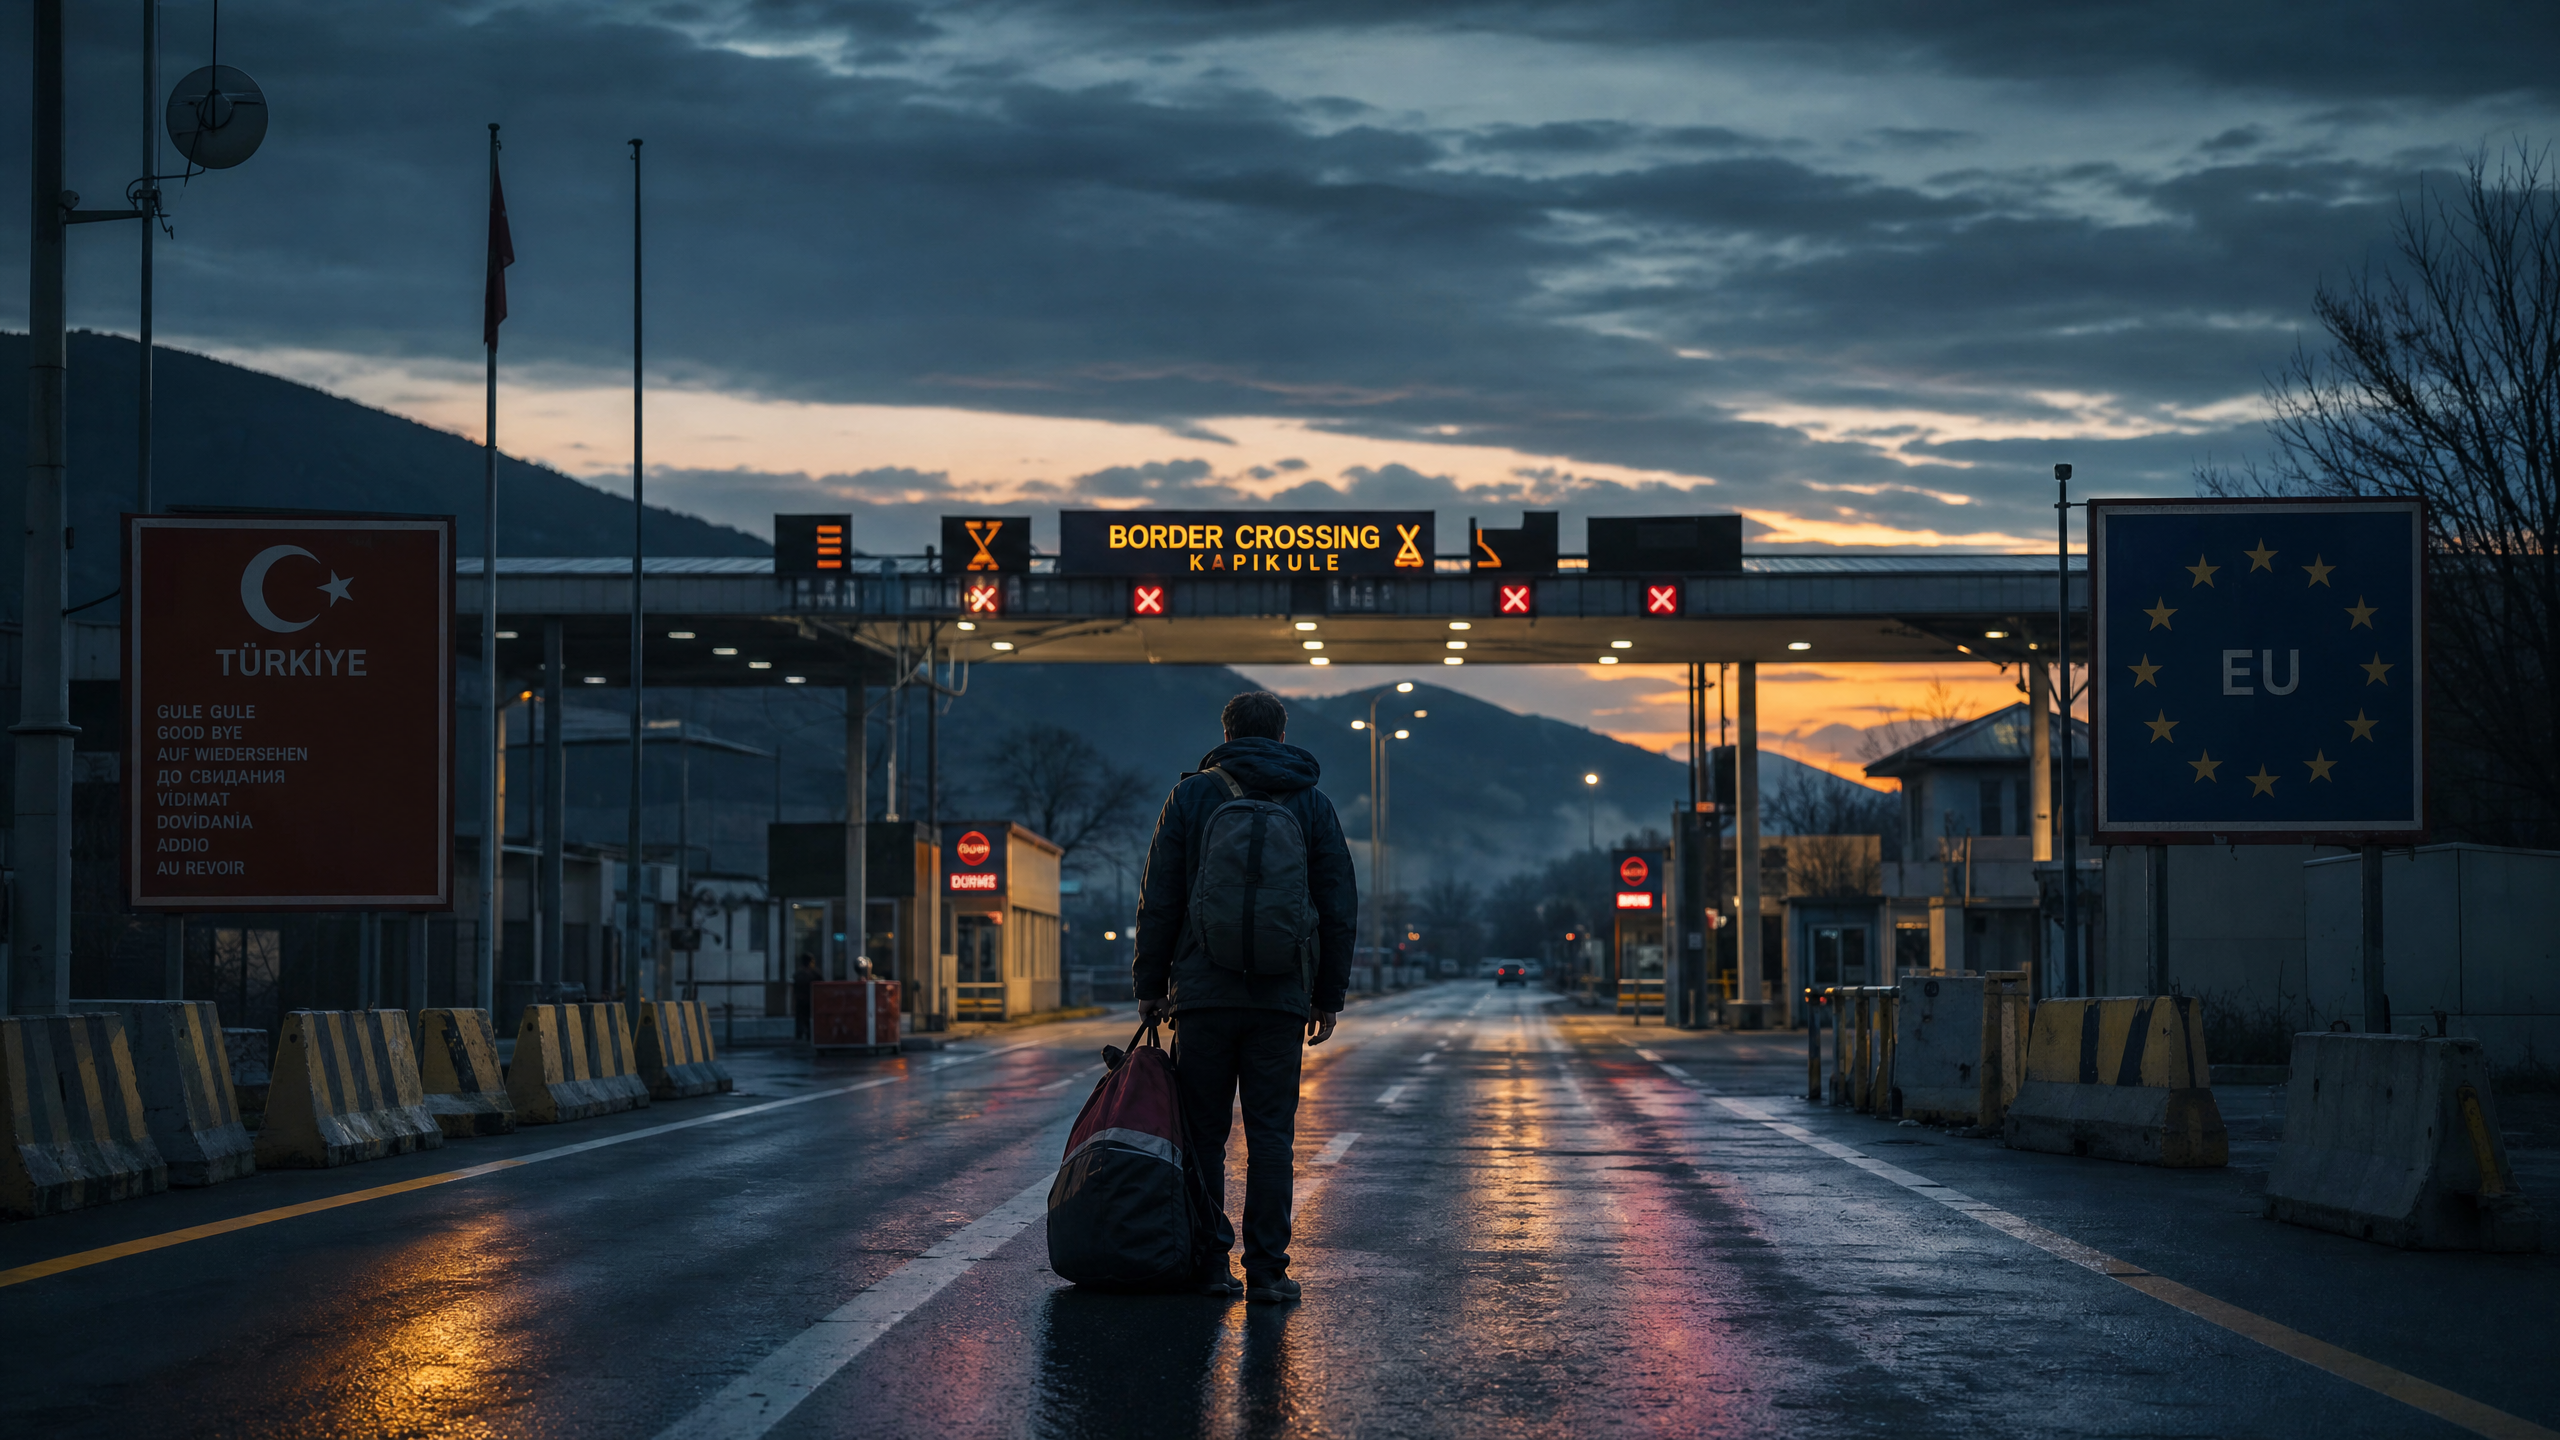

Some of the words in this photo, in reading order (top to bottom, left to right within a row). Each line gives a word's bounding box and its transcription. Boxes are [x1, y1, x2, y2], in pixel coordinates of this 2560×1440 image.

[1109, 524, 1224, 550] BORDER
[1235, 524, 1380, 550] CROSSING
[1189, 553, 1339, 572] KAPIKULE
[215, 642, 367, 677] TÜRKİYE
[2222, 649, 2299, 696] EU
[157, 704, 202, 719] GULE
[210, 704, 256, 719] GULE
[157, 725, 205, 740] GOOD
[211, 725, 243, 740] BYE
[157, 747, 190, 762] AUF
[194, 747, 308, 762] WIEDERSEHEN
[156, 769, 183, 787] ДО
[189, 769, 285, 787] СВИДАНИЯ
[156, 838, 209, 853] ADDIO
[156, 860, 180, 875] AU
[185, 860, 245, 875] REVOIR
